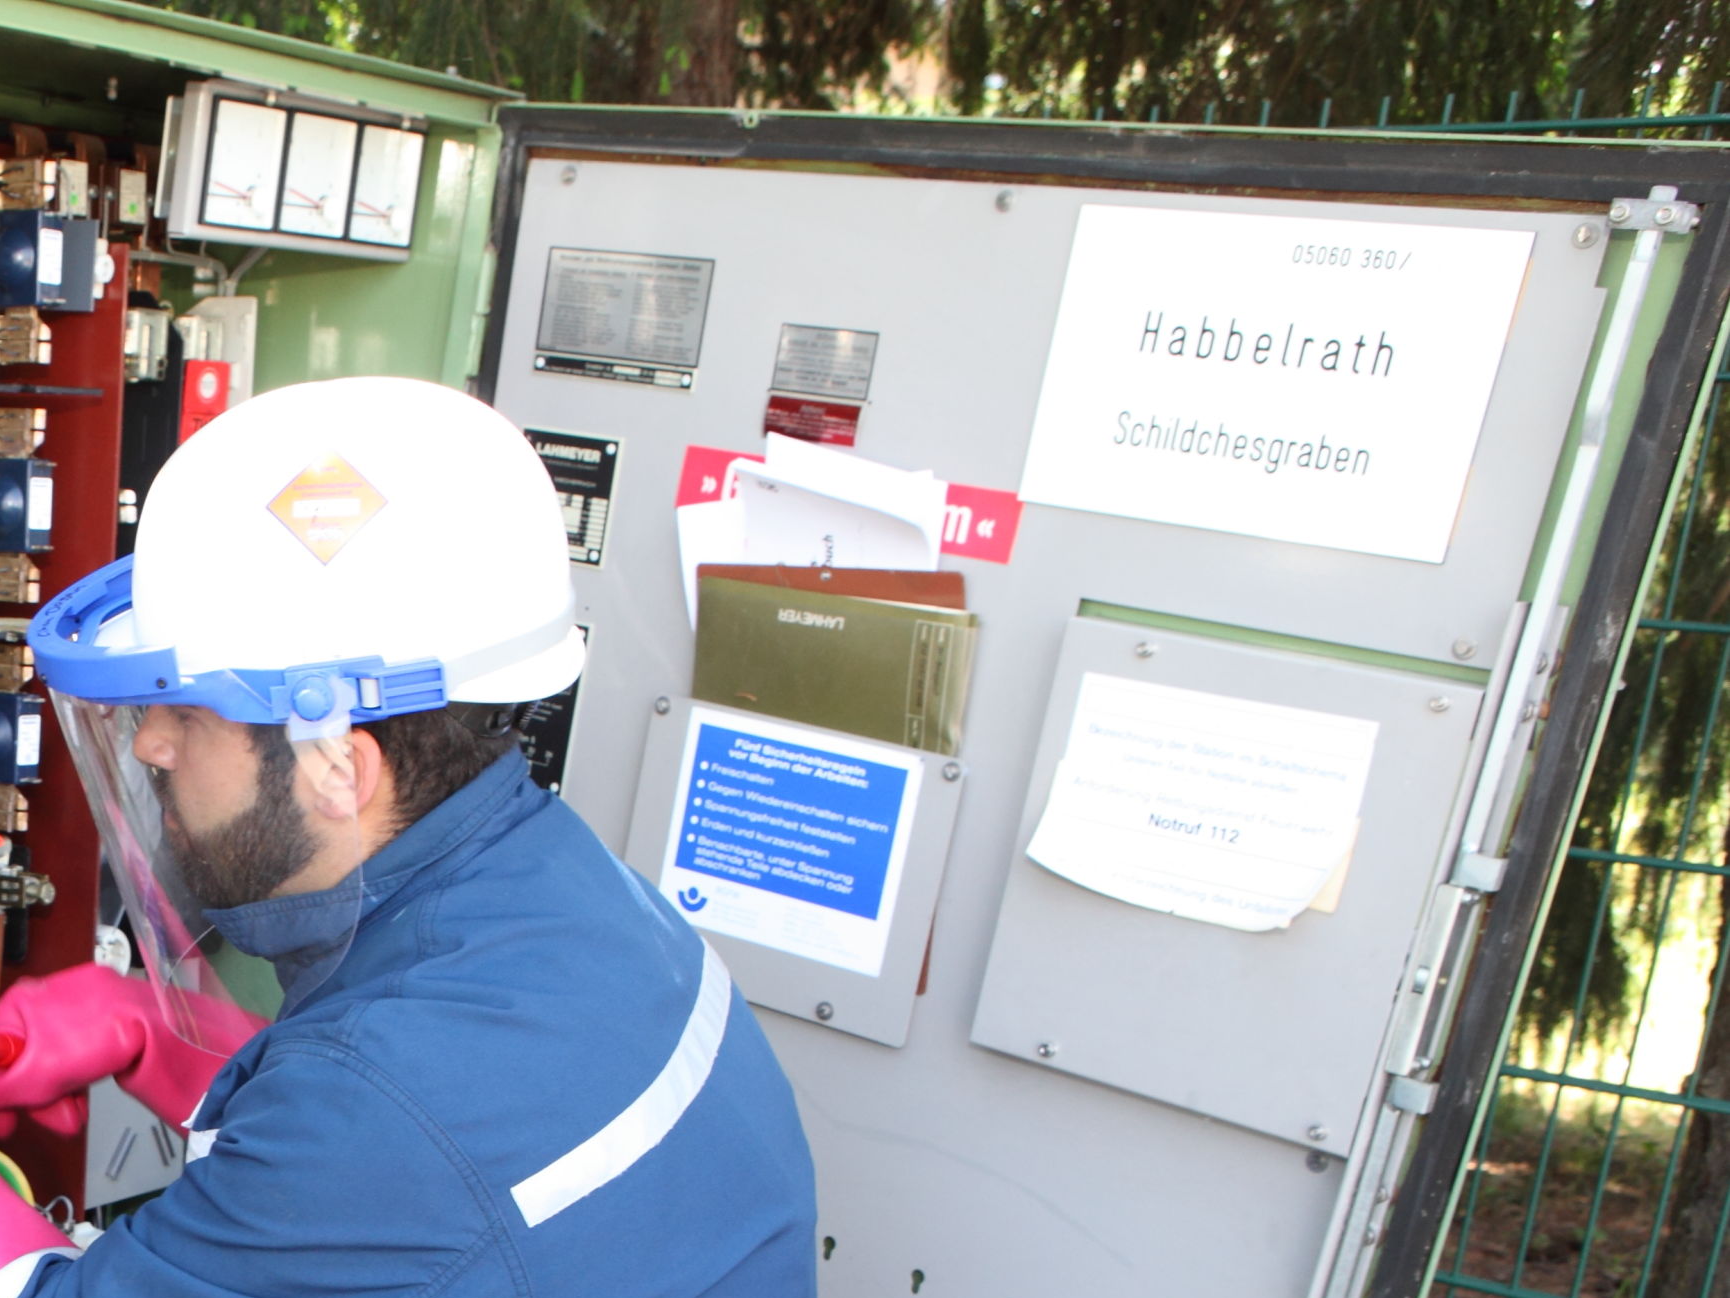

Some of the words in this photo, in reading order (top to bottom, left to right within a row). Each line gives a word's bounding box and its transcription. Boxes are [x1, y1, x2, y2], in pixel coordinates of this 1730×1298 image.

[1292, 244, 1352, 268] 05060
[1360, 249, 1412, 271] 360/
[1139, 310, 1395, 377] Habbelrath
[535, 442, 602, 463] LAHMEYER
[1113, 411, 1371, 475] Schildchesgraben
[777, 608, 846, 630] LAHMEYER
[728, 750, 747, 760] vor
[748, 754, 790, 771] Beginn
[791, 765, 811, 775] der
[735, 739, 761, 752] Fünf
[761, 747, 866, 777] Sicherheitsregeln
[711, 764, 774, 785] Freischalten
[704, 800, 798, 832] Spannungsfreiheit
[800, 824, 855, 844] feststellen
[707, 782, 743, 798] Gegen
[745, 791, 844, 821] Wiedereinschalten
[846, 816, 888, 832] sichern
[701, 819, 731, 832] Erden
[733, 827, 754, 838] und
[1148, 813, 1203, 836] Notruf
[1211, 825, 1241, 844] 112
[694, 857, 760, 880] abschranken
[696, 847, 744, 865] stehende
[746, 860, 769, 872] Teile
[771, 867, 824, 887] abdecken
[826, 882, 852, 894] oder
[768, 855, 795, 868] unter
[797, 862, 854, 885] Spannung
